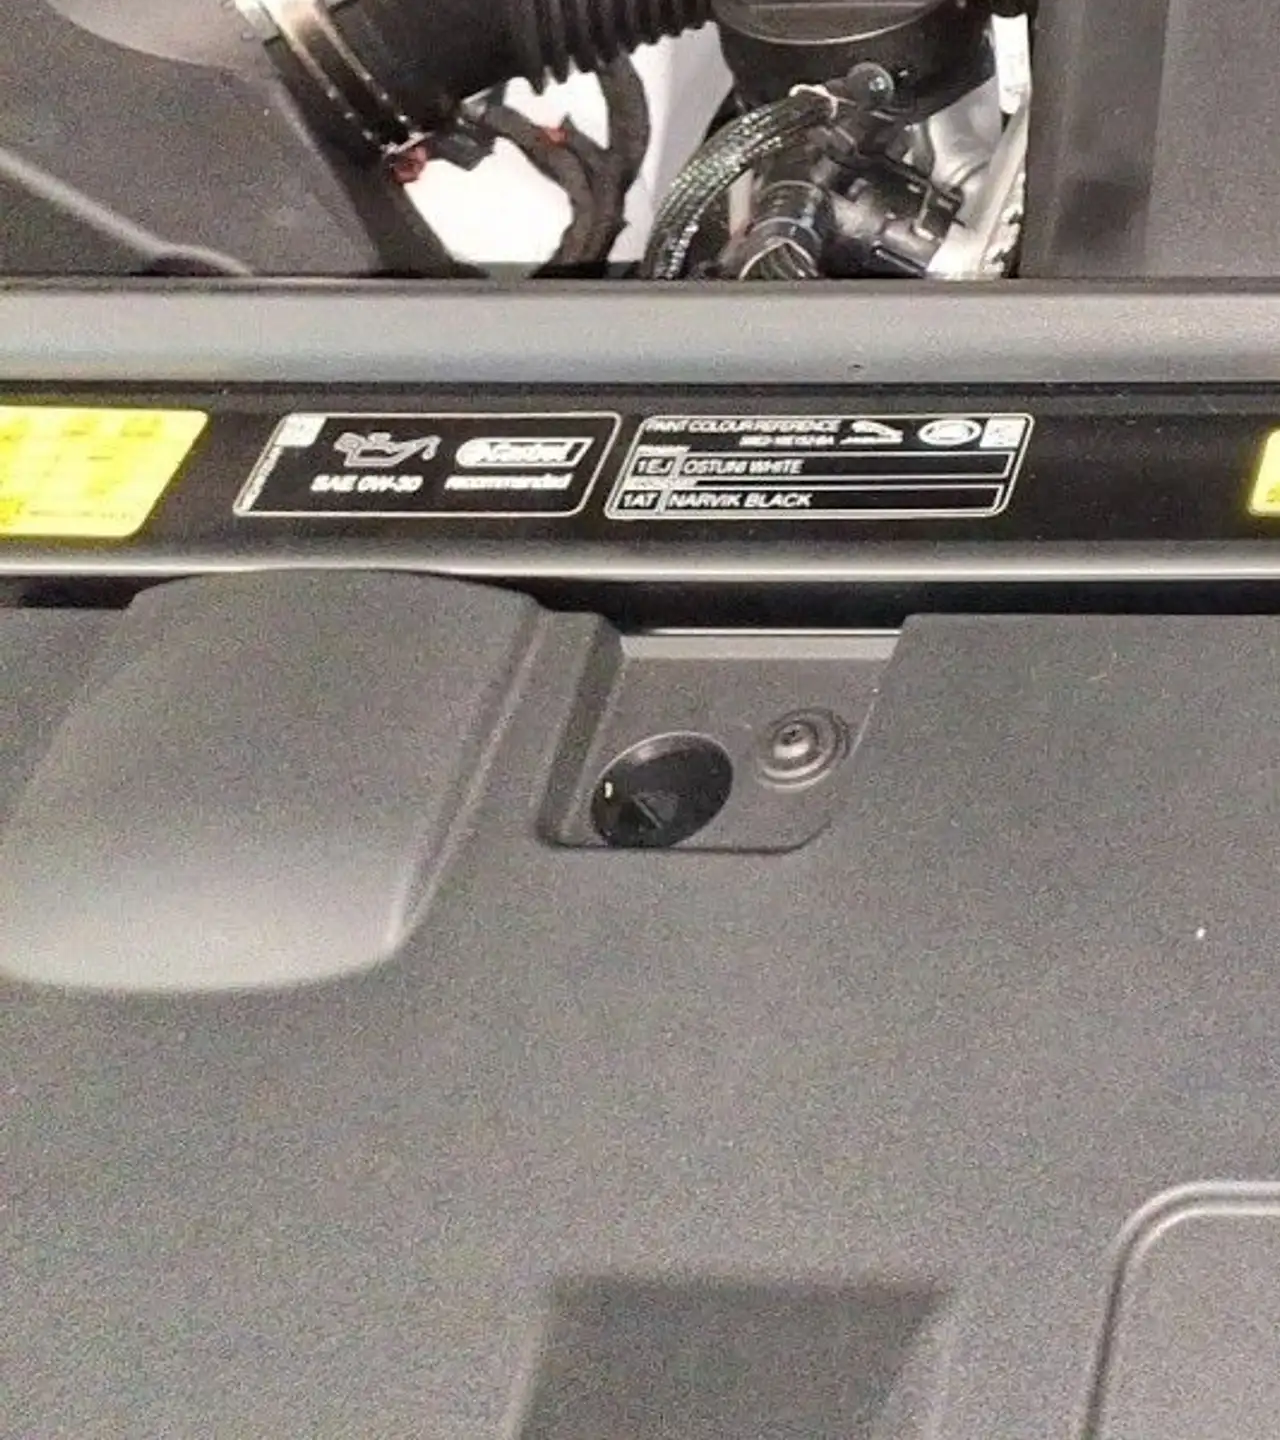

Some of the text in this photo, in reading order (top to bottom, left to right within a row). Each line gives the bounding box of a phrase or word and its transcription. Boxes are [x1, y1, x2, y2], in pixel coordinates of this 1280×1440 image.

[644, 419, 842, 433] PAINT COLOUR REFERENCE
[638, 461, 674, 475] 1EJ
[748, 460, 804, 475] WHITE
[310, 474, 359, 492] SAE
[623, 493, 658, 508] 1AT
[666, 493, 813, 508] NARVIK BLACK
